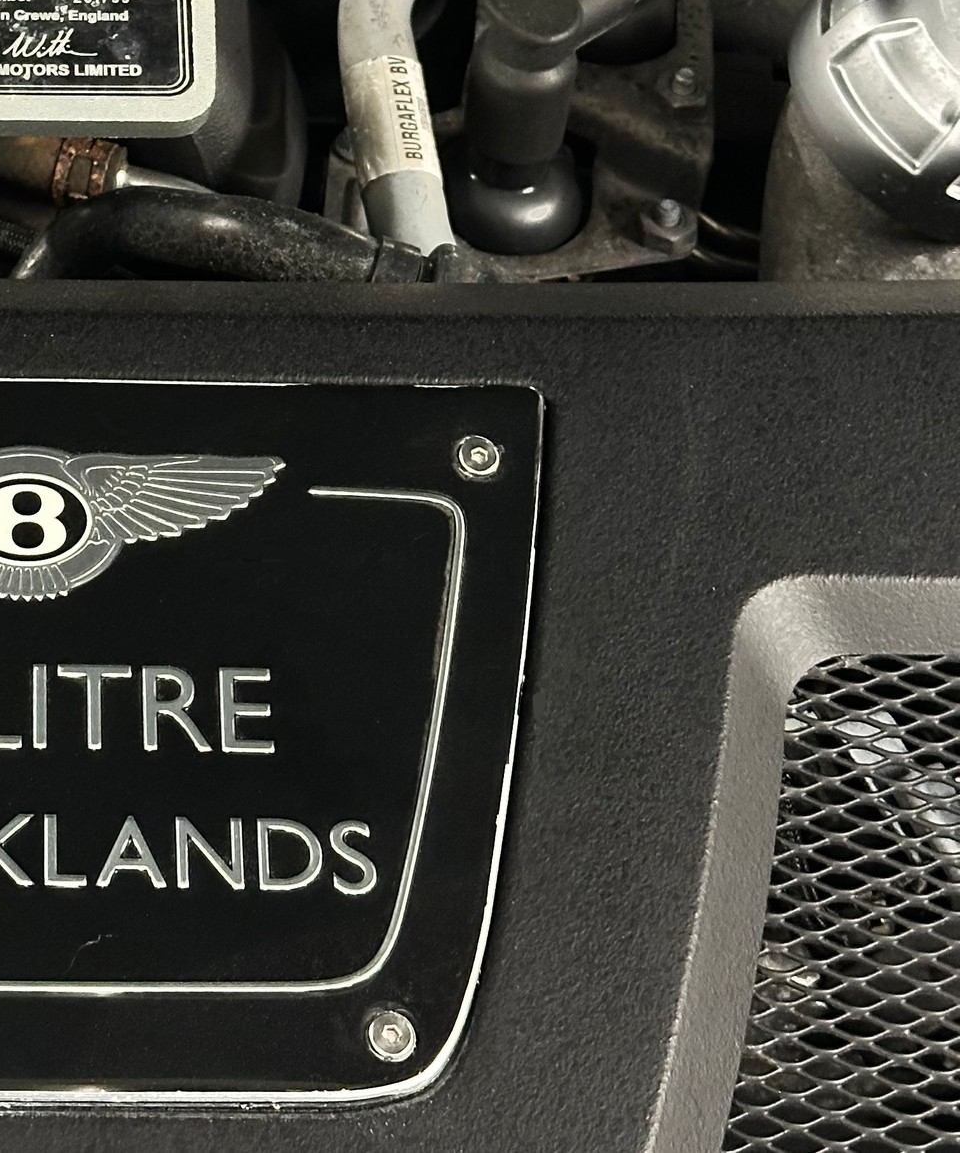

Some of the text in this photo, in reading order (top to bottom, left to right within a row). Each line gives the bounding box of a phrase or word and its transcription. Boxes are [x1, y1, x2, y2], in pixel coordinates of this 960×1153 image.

[67, 9, 130, 24] England
[74, 63, 143, 78] LIMITED
[391, 79, 424, 160] BURGAFLEX
